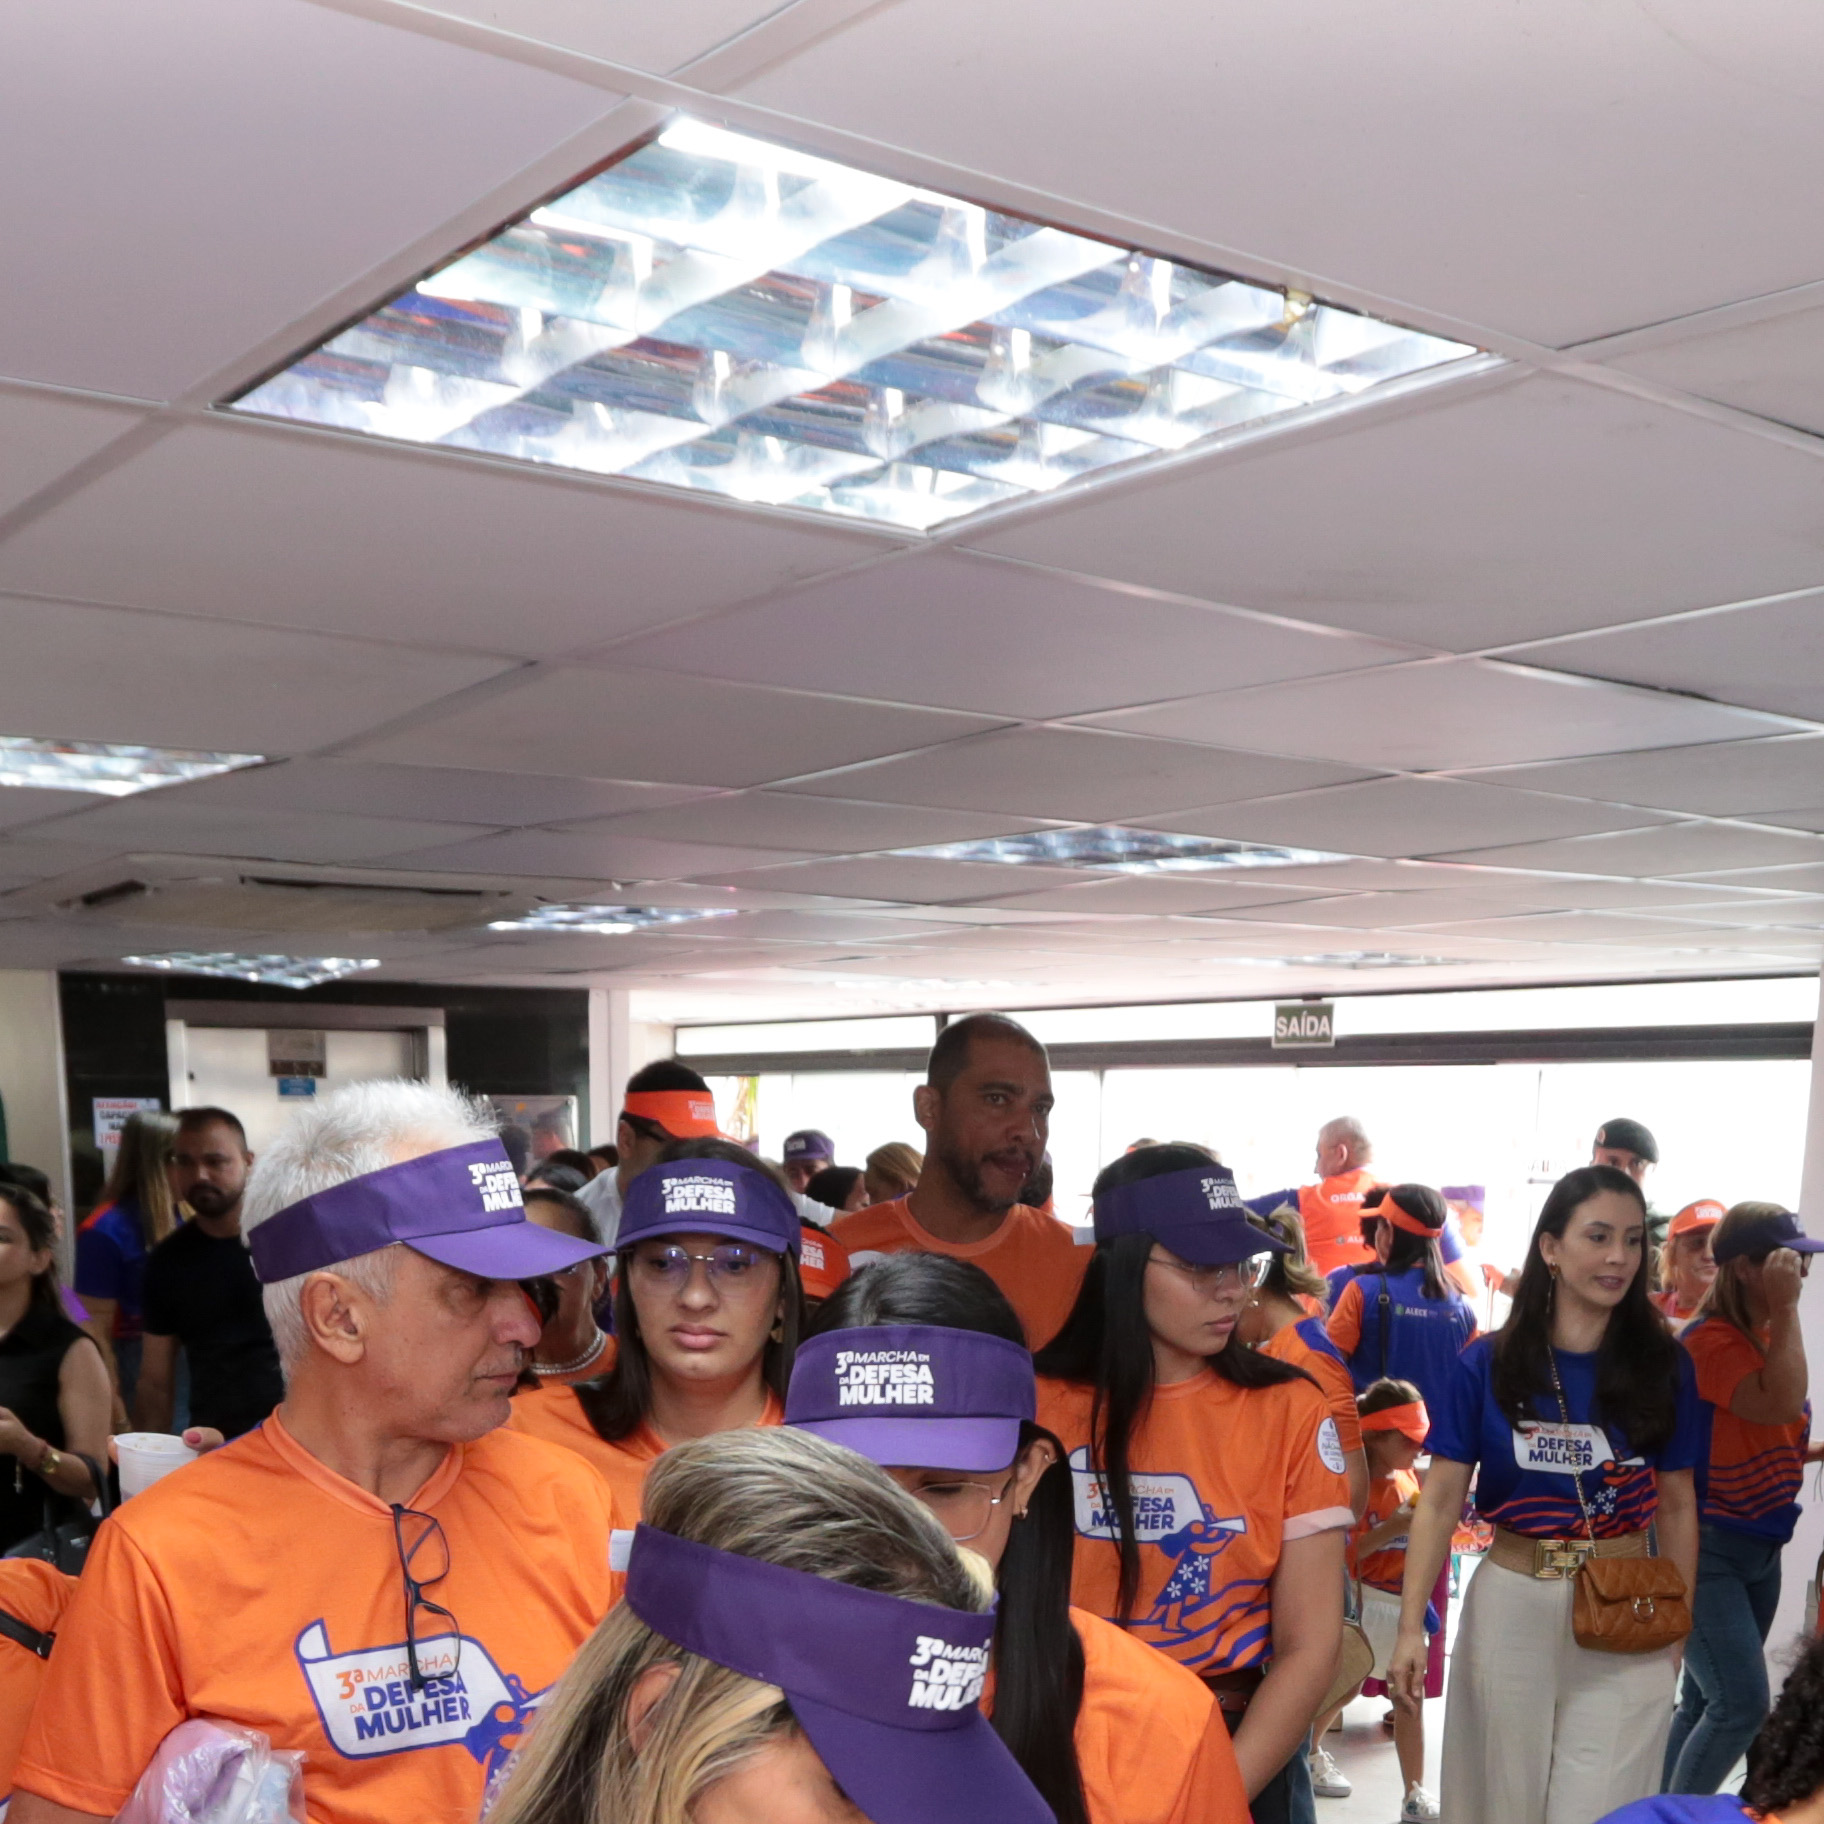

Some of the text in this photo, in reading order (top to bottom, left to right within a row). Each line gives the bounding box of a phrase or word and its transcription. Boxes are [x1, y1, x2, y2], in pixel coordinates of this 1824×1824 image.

[1276, 1010, 1331, 1038] SAÍDA
[672, 1185, 736, 1202] DEFESA
[665, 1197, 736, 1215] MULHER
[834, 1350, 855, 1375] 3ª
[854, 1351, 918, 1364] MARCHA
[849, 1363, 934, 1385] DEFESA
[839, 1384, 934, 1406] MULHER
[1537, 1436, 1593, 1453] DEFESA
[1528, 1449, 1592, 1466] MULHER
[908, 1635, 946, 1667] 3ª
[336, 1668, 365, 1700] 3ª
[349, 1703, 366, 1714] DA
[353, 1696, 472, 1741] MULHER
